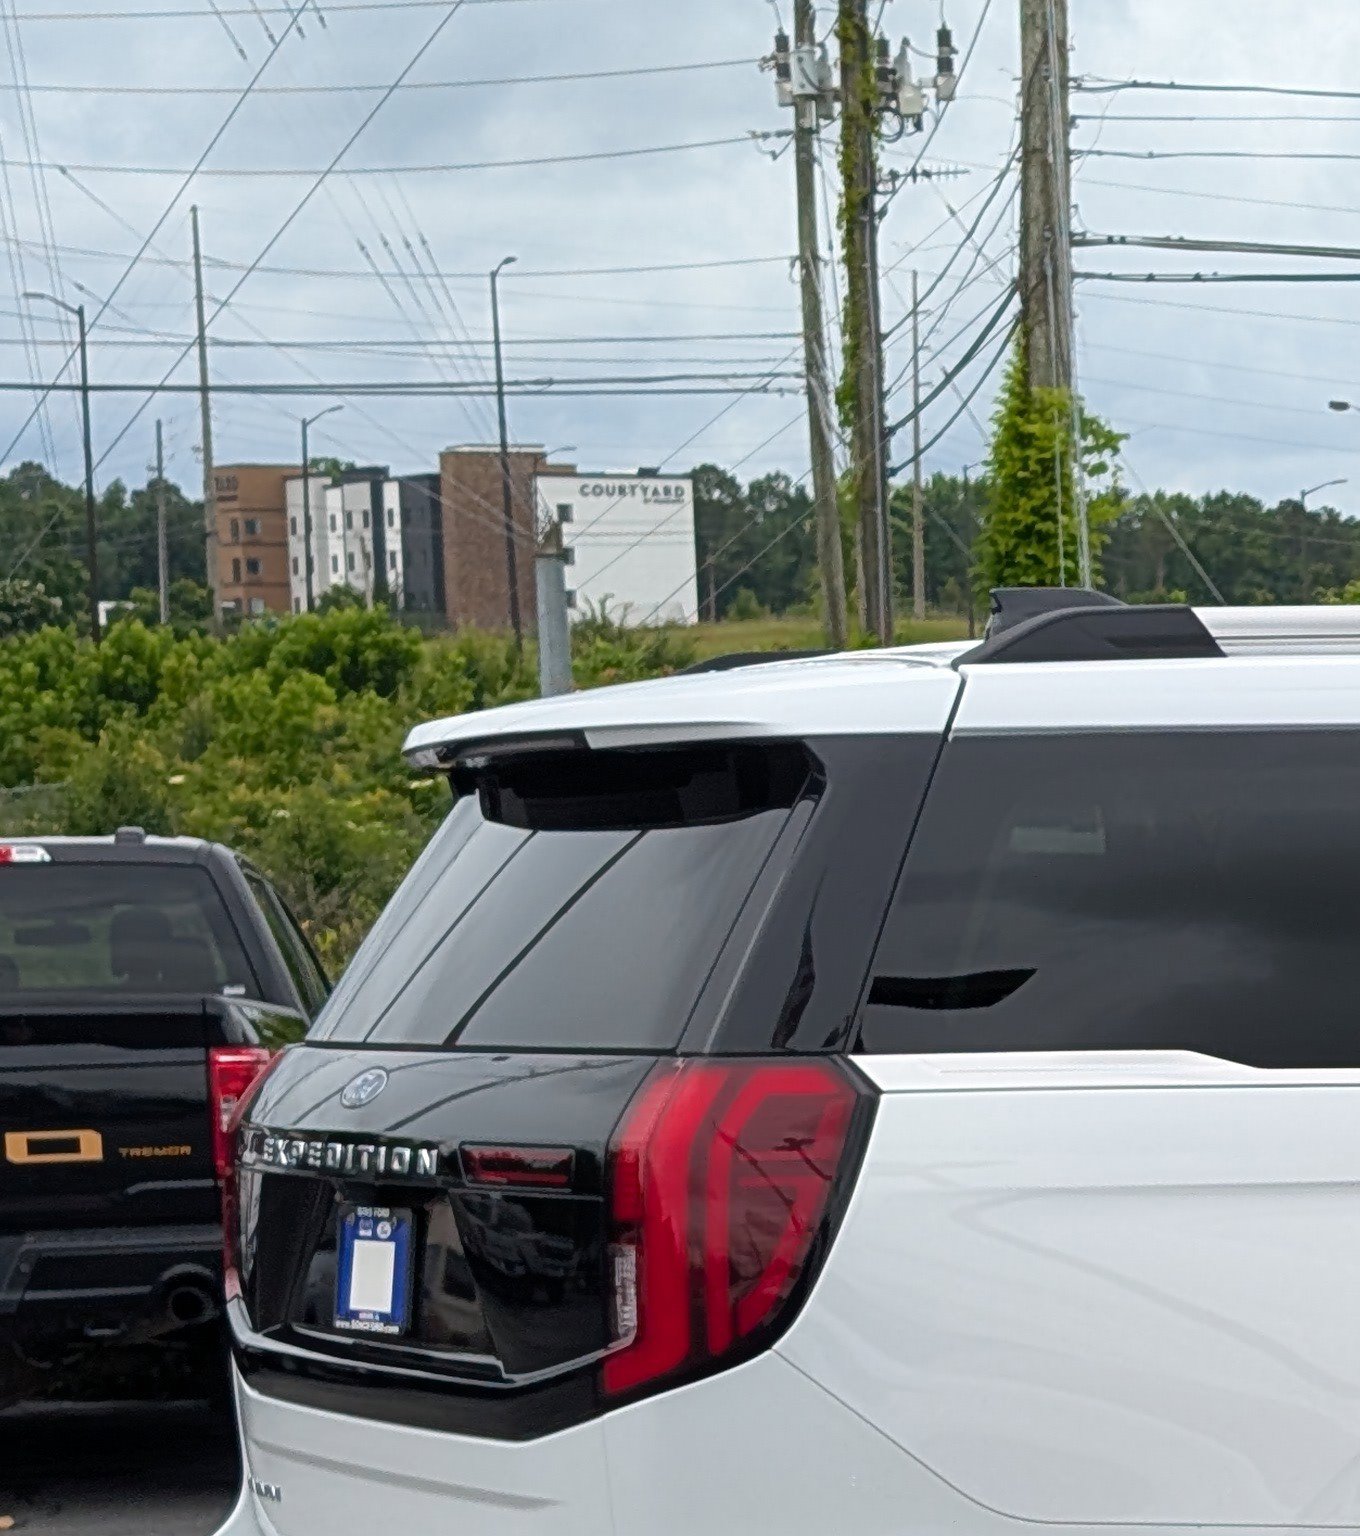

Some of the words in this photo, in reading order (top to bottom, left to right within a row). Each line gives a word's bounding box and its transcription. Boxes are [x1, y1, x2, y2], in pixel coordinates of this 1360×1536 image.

[579, 483, 686, 498] COURTYARD
[118, 1145, 192, 1158] TREMOR
[262, 1137, 440, 1176] EXPEDITION
